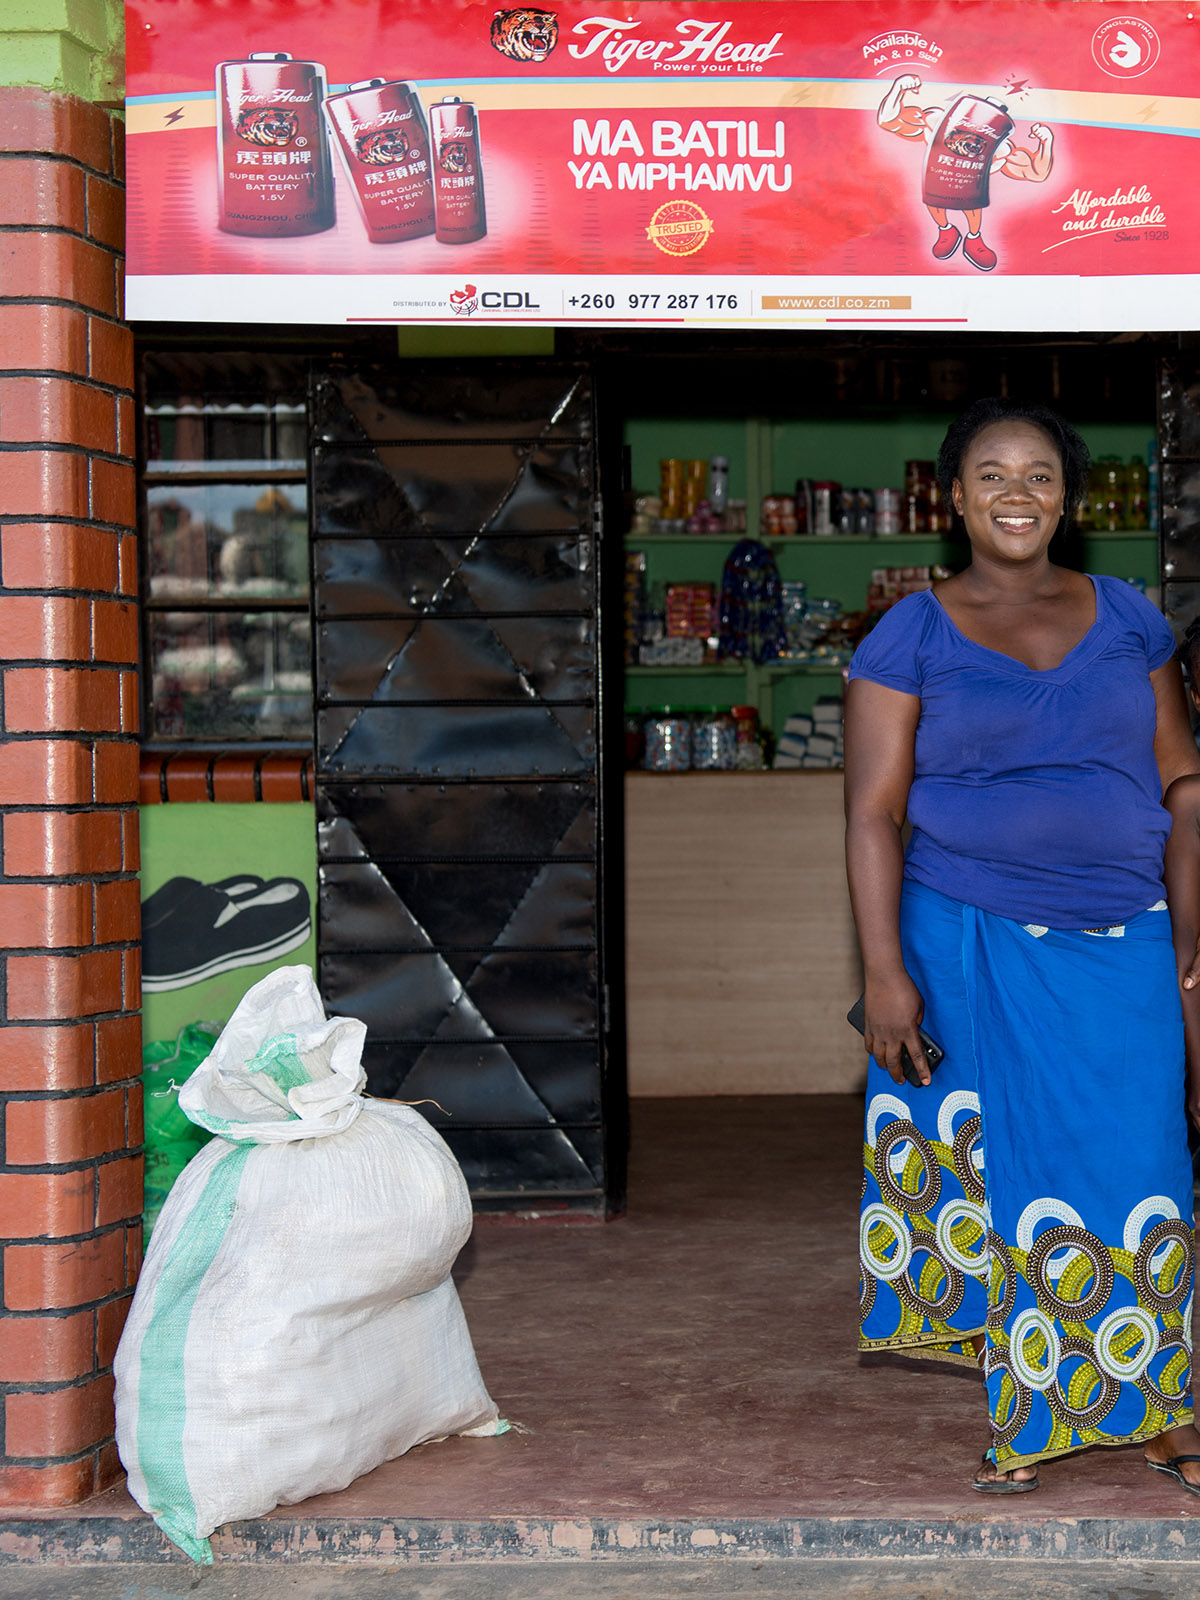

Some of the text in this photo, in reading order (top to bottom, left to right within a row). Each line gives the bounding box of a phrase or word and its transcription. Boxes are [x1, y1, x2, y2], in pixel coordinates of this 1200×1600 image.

[568, 16, 784, 72] Tiger Head
[862, 33, 943, 58] Available in
[873, 49, 938, 66] AA & D Size
[653, 62, 763, 73] Power your Life
[268, 88, 313, 103] Head
[377, 109, 414, 127] Head
[573, 119, 785, 158] MA BATILI
[236, 151, 311, 165] 虎頭牌
[229, 172, 316, 181] SUPER QUALITY
[567, 161, 792, 192] YA MPHAMVU
[364, 189, 394, 199] SUPER
[381, 190, 424, 206] BATTERY
[1051, 185, 1152, 216] Affordable
[1062, 205, 1166, 231] and durable
[655, 222, 703, 235] TRUSTED
[1113, 231, 1169, 243] Since 1928
[481, 292, 540, 308] CDL
[568, 294, 738, 309] +260 977 287 176
[778, 296, 890, 308] www.cdl.co.zm
